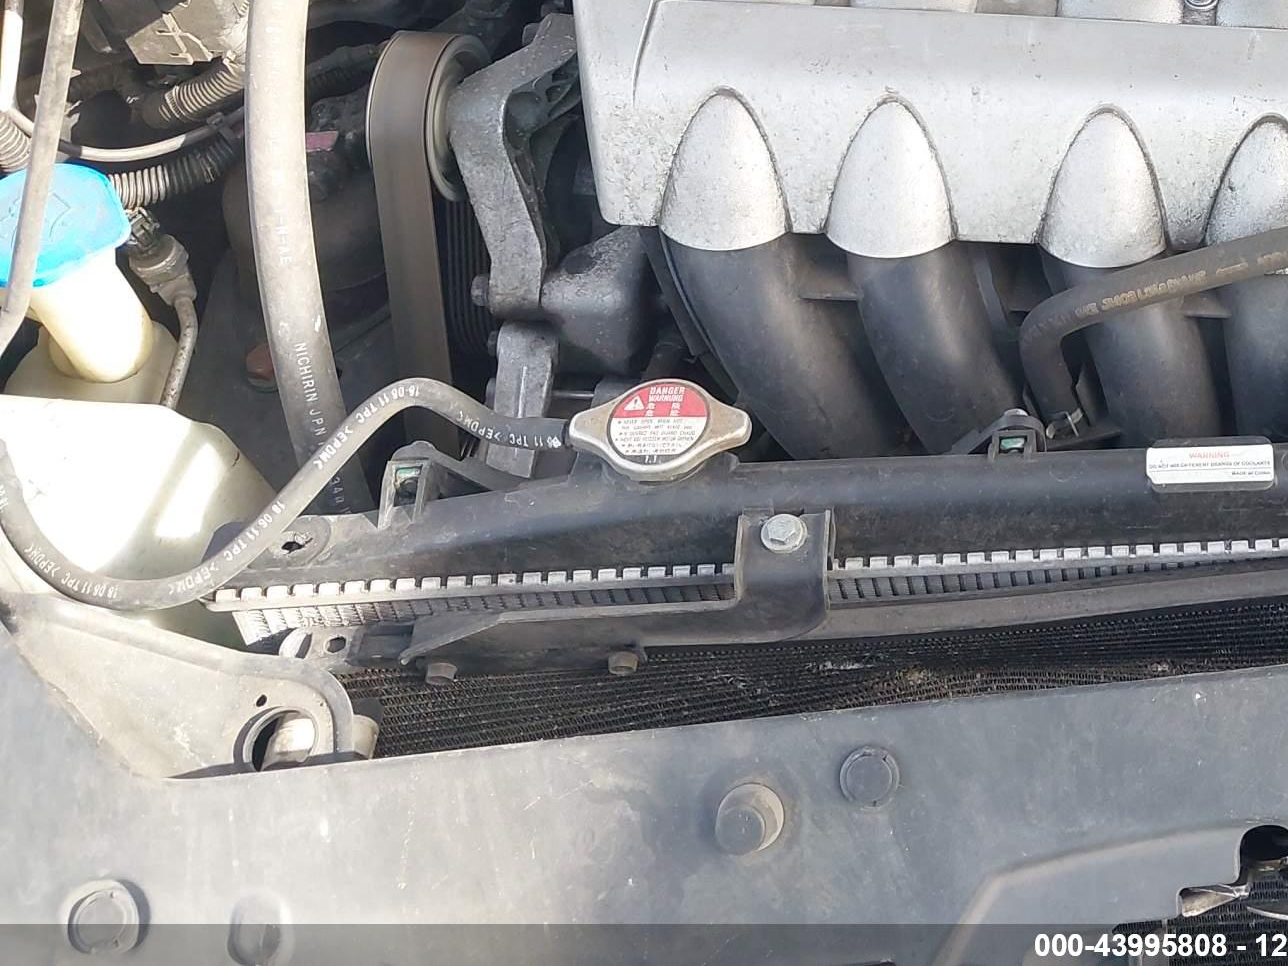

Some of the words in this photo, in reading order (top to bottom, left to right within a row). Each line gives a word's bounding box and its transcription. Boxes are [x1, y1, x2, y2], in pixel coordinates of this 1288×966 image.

[294, 342, 318, 402] NICHIRIN
[309, 409, 327, 436] JPN
[649, 386, 686, 395] DANGER
[355, 397, 378, 424] TPC
[509, 433, 530, 447] TPC
[1189, 451, 1231, 459] WARNING
[271, 500, 286, 515] 18
[256, 515, 273, 530] 06
[245, 527, 260, 542] 11
[223, 539, 248, 563] TPC
[61, 572, 81, 592] TPC
